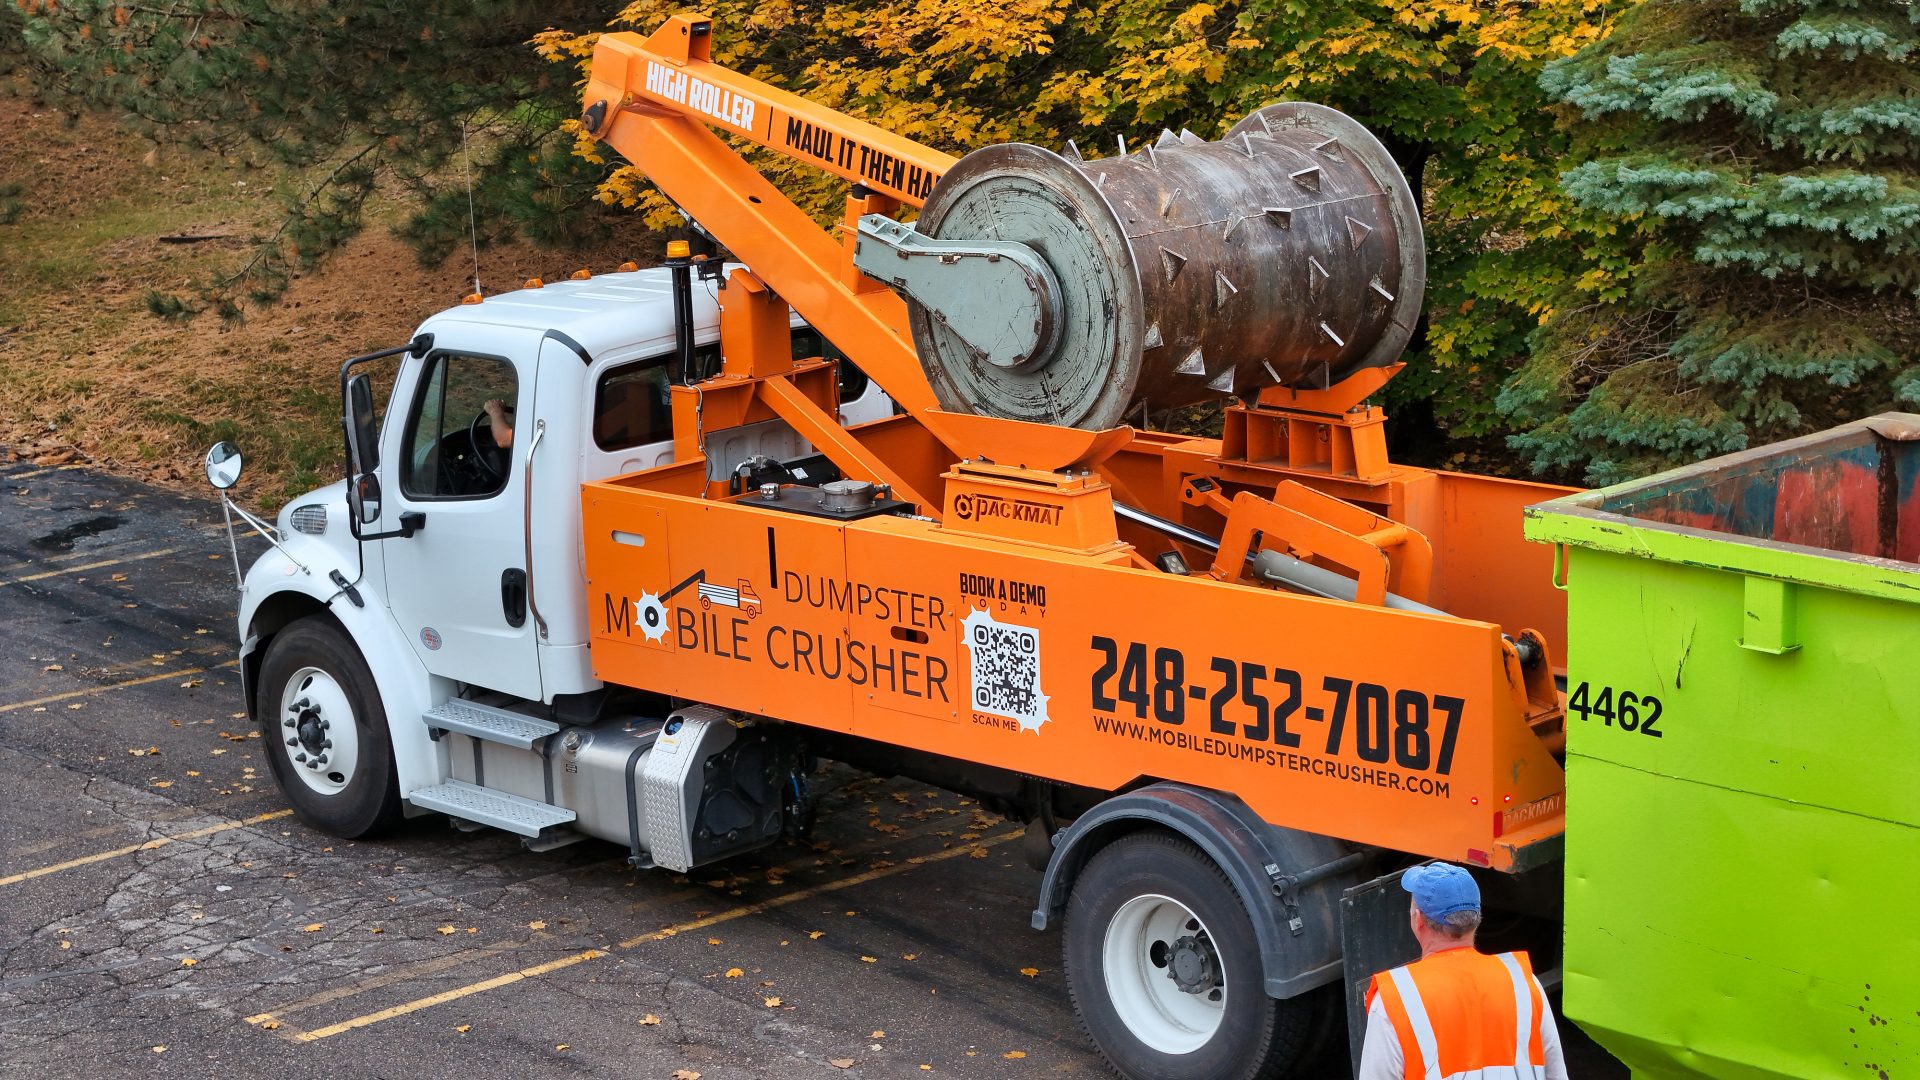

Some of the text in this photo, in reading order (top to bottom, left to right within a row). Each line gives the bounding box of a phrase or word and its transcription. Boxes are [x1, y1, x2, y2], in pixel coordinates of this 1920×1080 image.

[645, 61, 755, 131] HIGH ROLLER
[785, 116, 942, 200] MAUL IT THEN HA
[784, 571, 946, 631] DUMPSTER
[959, 572, 1046, 607] BOOK A DEMO
[766, 625, 950, 704] CRUSHER
[972, 713, 1017, 731] SCAN ME
[1090, 635, 1466, 776] 248-252-7087
[1568, 681, 1663, 738] 4462
[1093, 715, 1450, 799] WWW.MOBILEDUMPSTERCRUSHER.COM
